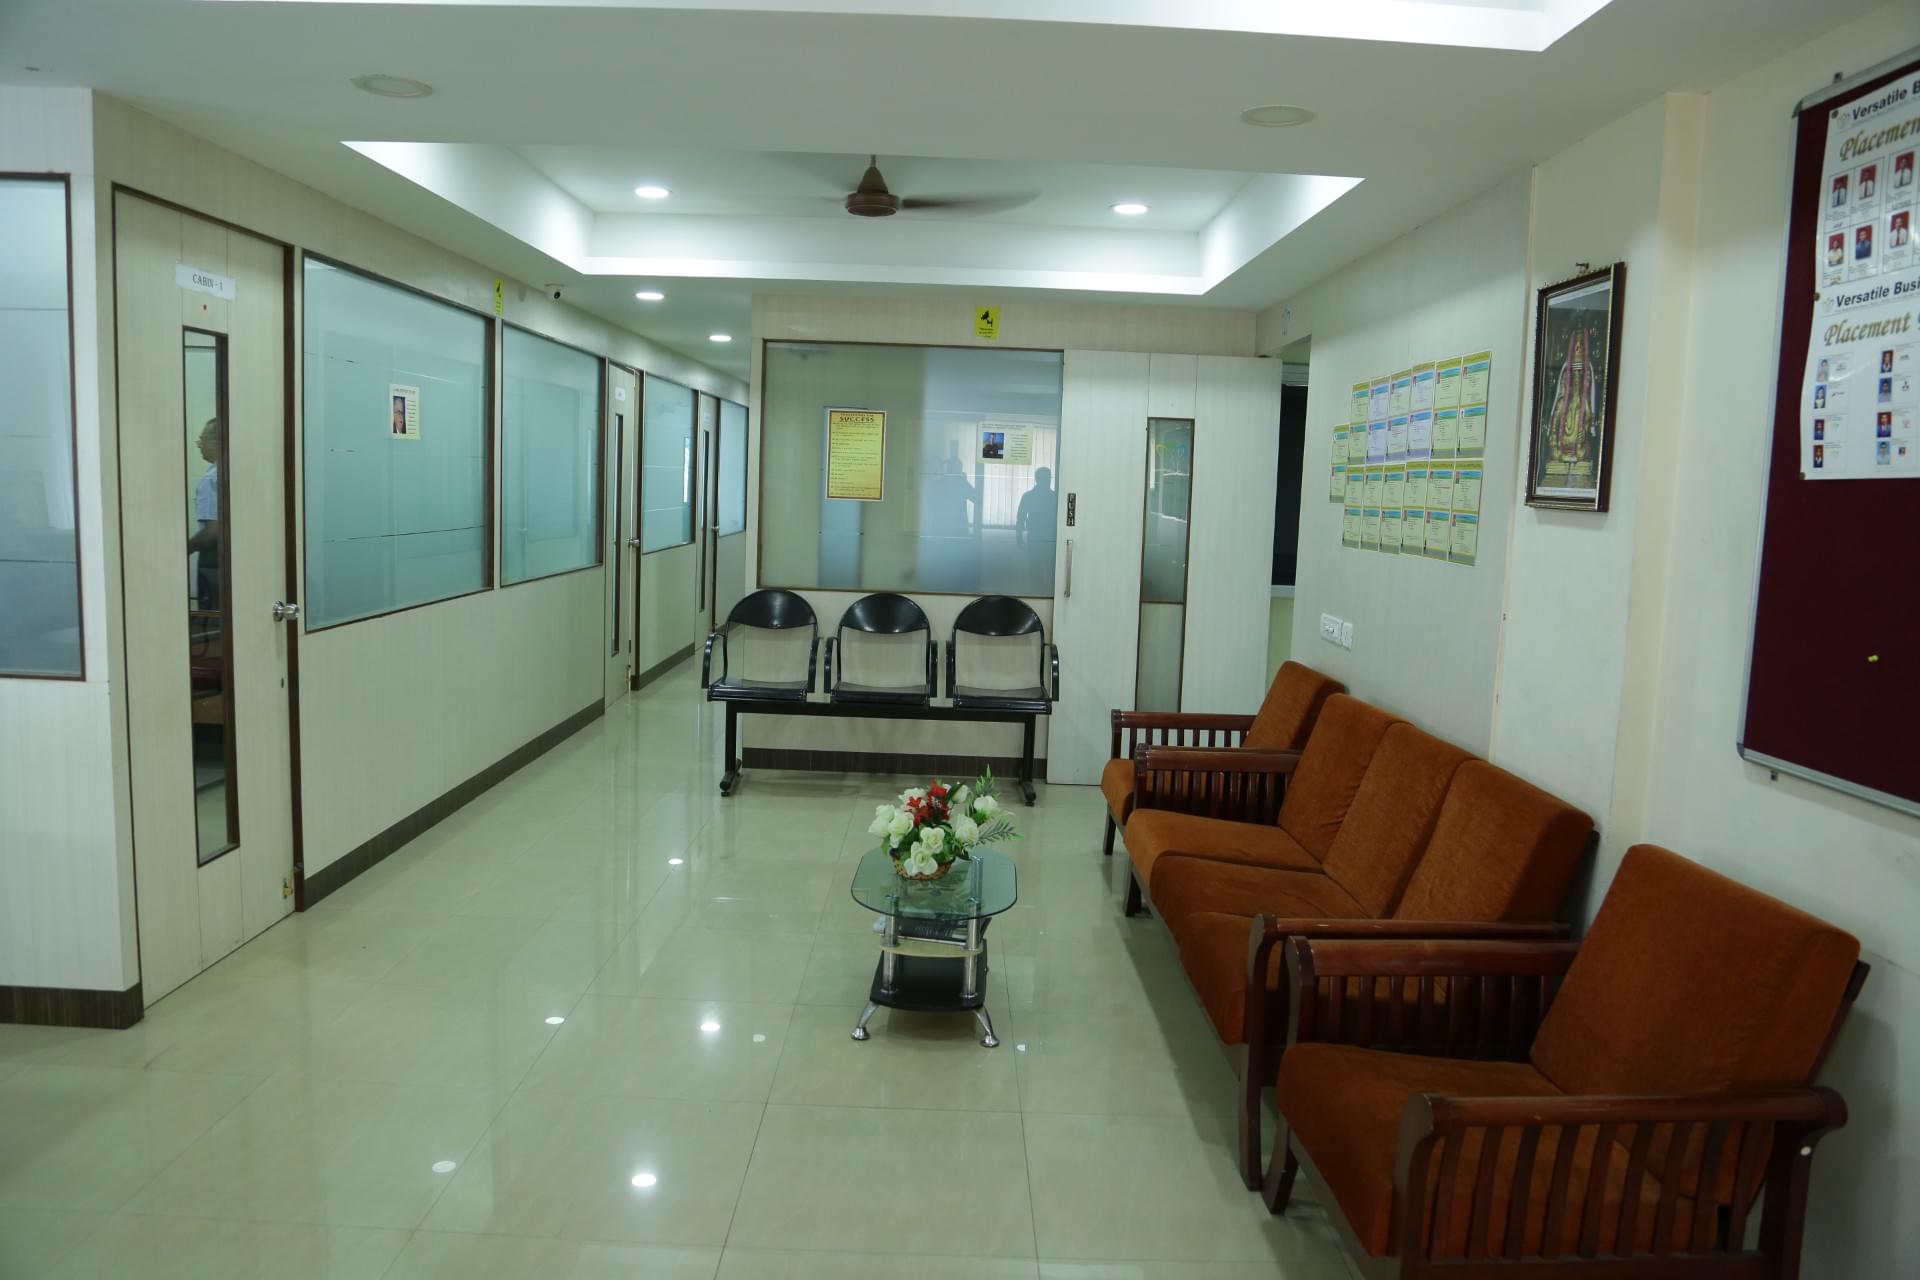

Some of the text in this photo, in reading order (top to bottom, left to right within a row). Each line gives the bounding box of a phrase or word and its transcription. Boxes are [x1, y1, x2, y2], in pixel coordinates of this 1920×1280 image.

[1852, 88, 1908, 121] Versatile
[192, 273, 214, 289] CABIN
[1836, 286, 1890, 307] Versatile
[1824, 312, 1911, 346] Placement
